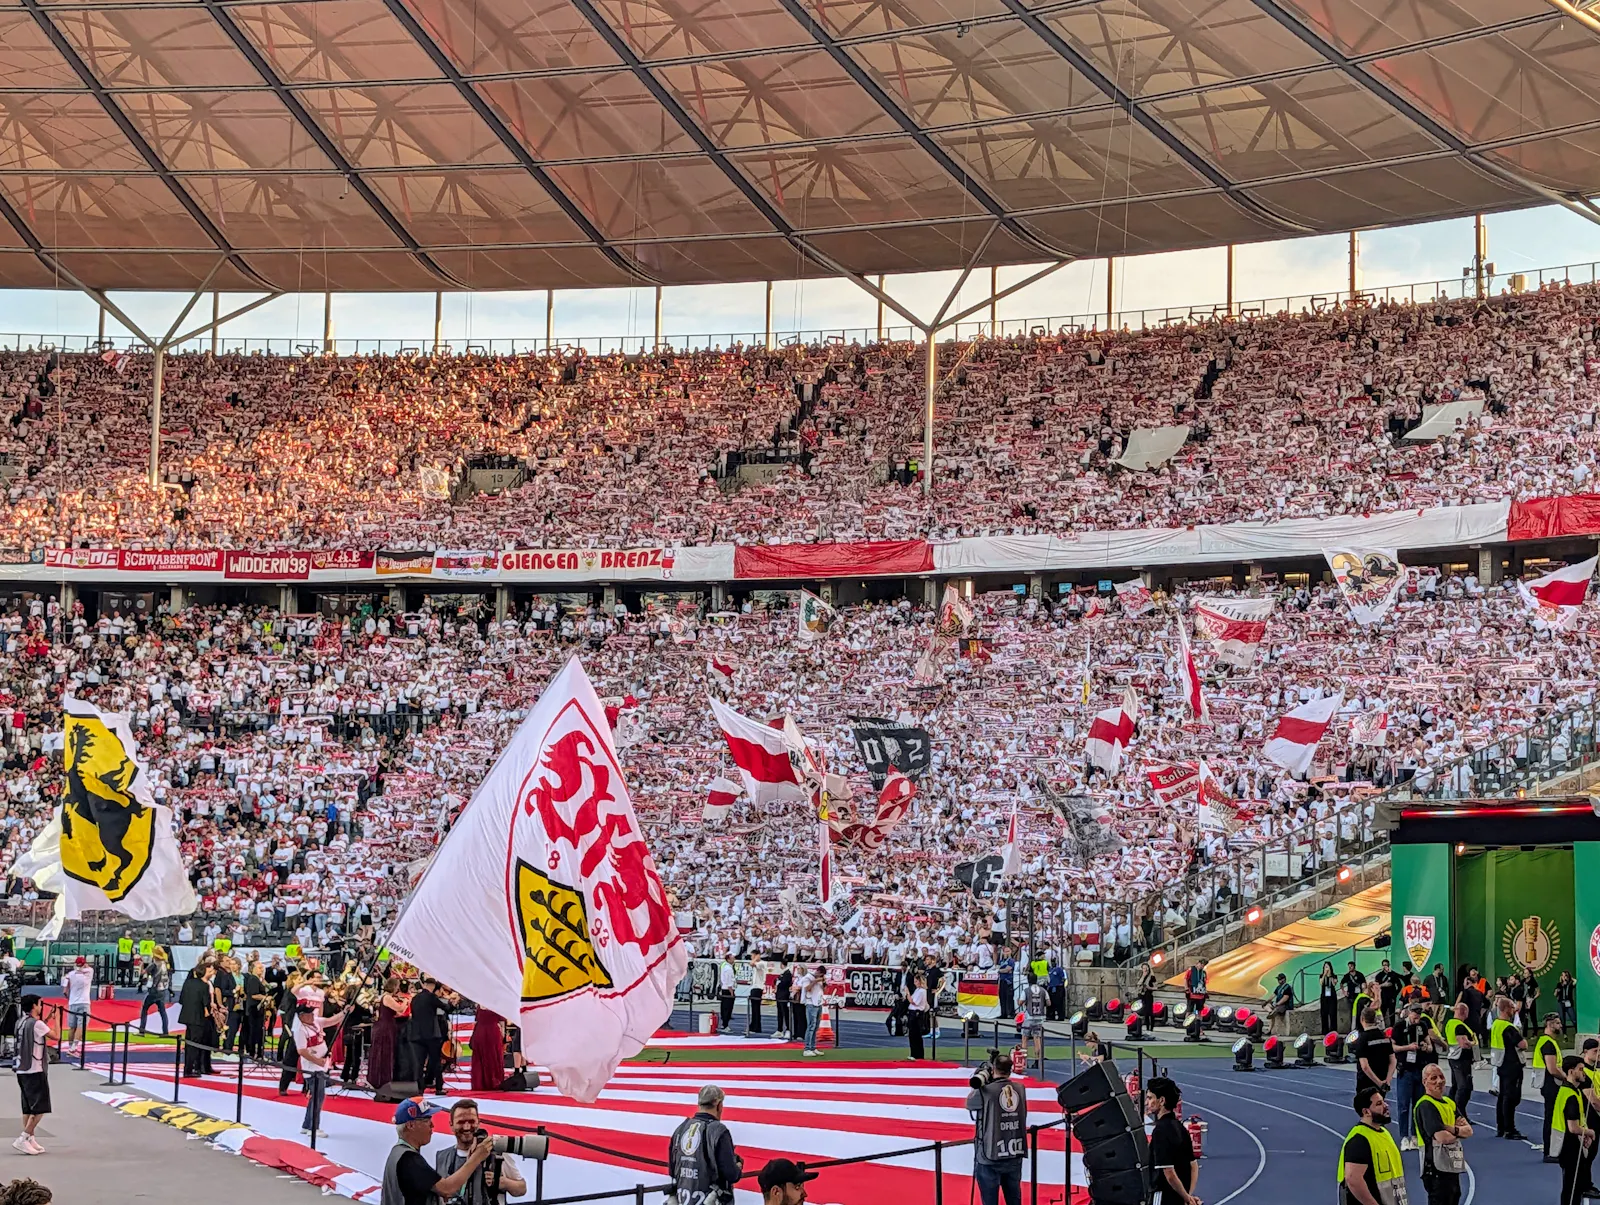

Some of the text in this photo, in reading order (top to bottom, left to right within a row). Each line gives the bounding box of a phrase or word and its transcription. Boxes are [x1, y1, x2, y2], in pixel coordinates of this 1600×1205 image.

[124, 552, 218, 567] SCHWABENFRONT
[502, 552, 578, 570] GIENGEN
[600, 549, 662, 569] BRENZ
